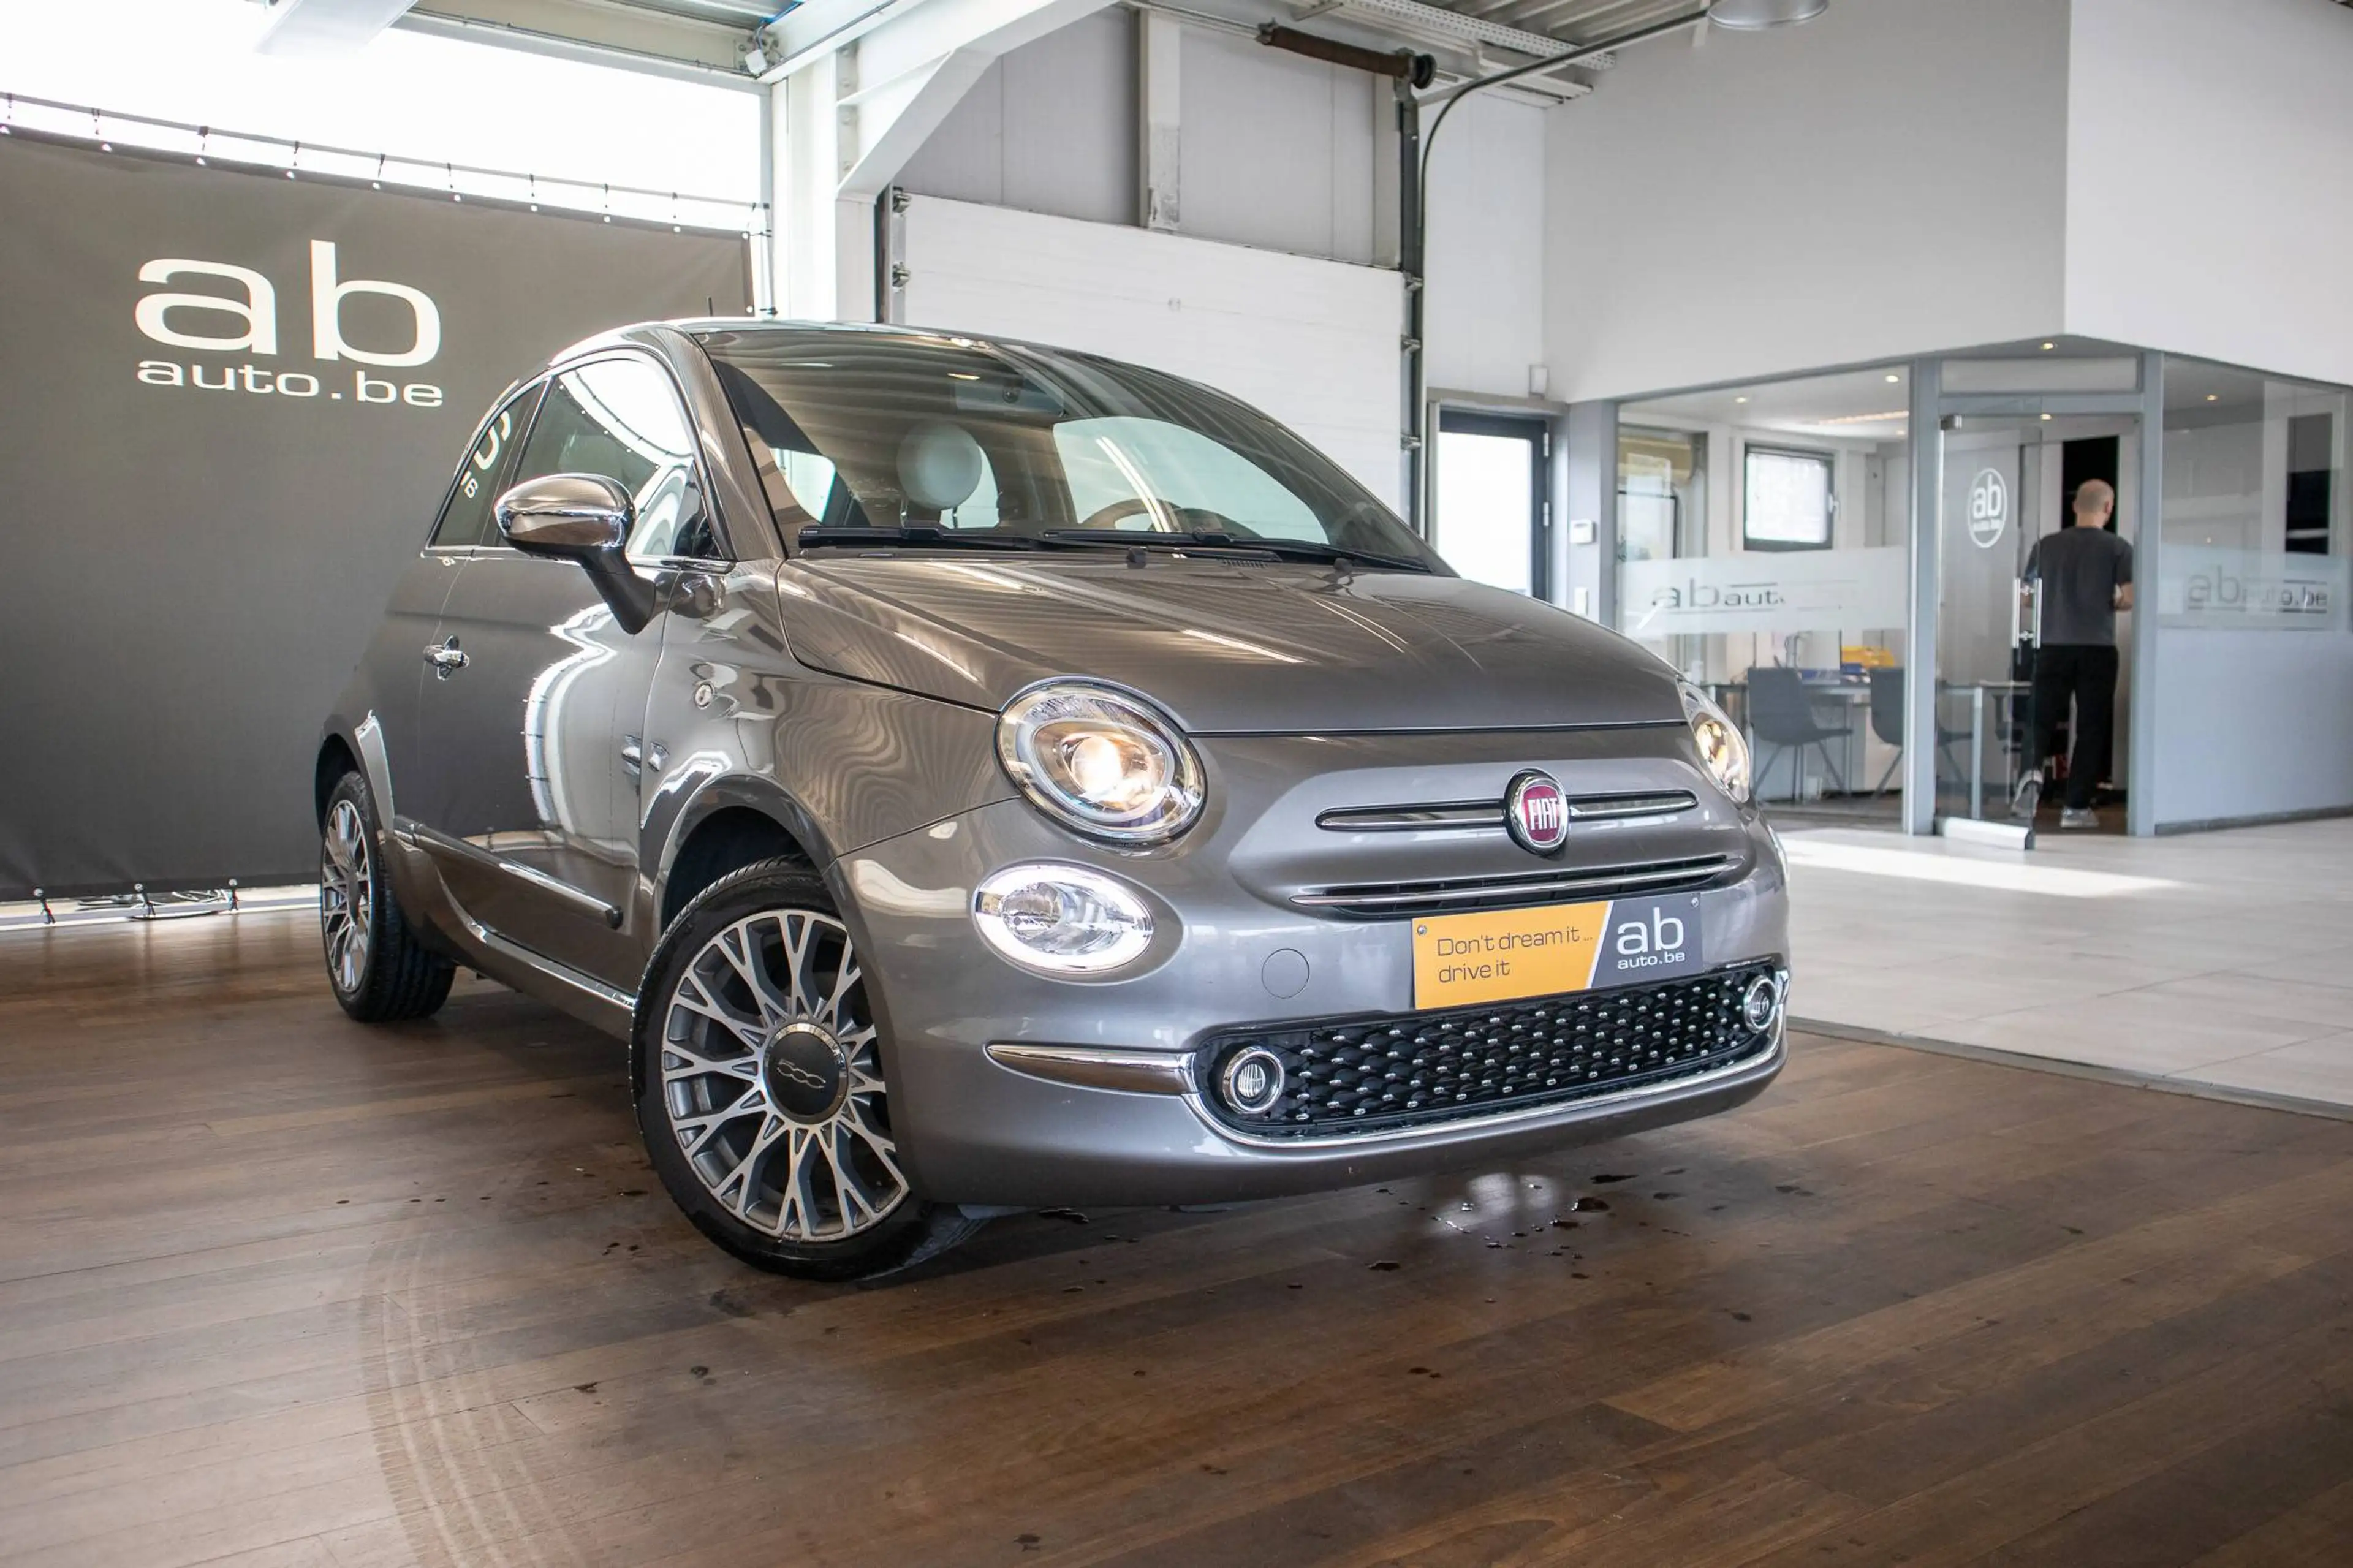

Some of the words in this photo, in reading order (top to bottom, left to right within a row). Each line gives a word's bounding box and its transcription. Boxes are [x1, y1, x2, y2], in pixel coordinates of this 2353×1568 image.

[135, 238, 441, 368] ab
[137, 360, 444, 407] auto.be
[1972, 473, 2002, 519] ab
[1527, 797, 1558, 831] FIAT
[1437, 934, 1495, 956] Don't
[1498, 931, 1563, 950] dream
[1616, 907, 1684, 955] ab
[1439, 963, 1491, 983] drive
[1495, 960, 1510, 977] it
[1617, 951, 1686, 970] auto.be
